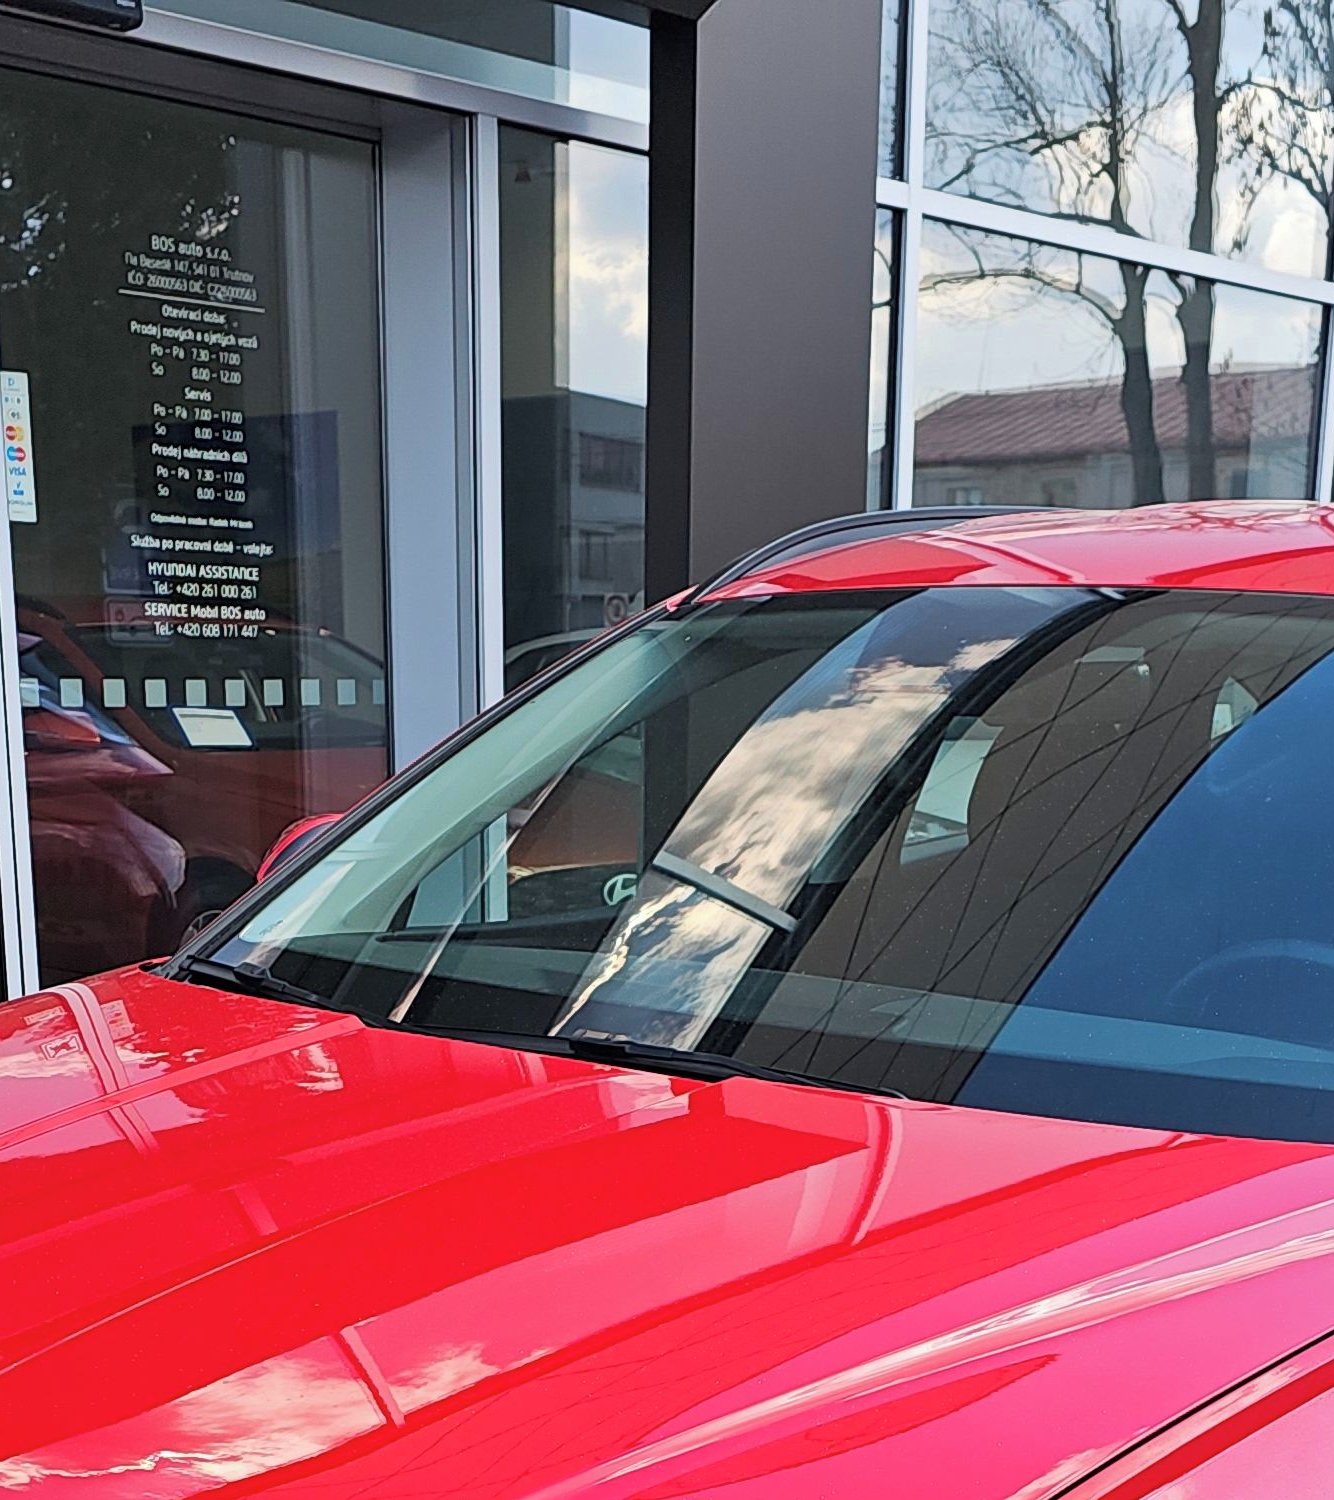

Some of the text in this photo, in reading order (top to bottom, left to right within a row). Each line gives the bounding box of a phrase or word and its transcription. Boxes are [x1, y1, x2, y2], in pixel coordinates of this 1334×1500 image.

[151, 235, 231, 261] BOS auto s.r.o.
[193, 262, 207, 275] 541
[223, 267, 254, 283] Trutnov
[131, 321, 161, 339] Prodej
[163, 327, 194, 341] nových
[151, 343, 163, 356] Po
[152, 362, 164, 375] So
[192, 367, 210, 381] 8.00
[220, 371, 242, 384] 12.00
[184, 386, 211, 401] Servis
[153, 403, 165, 416] Po
[193, 407, 212, 421] 7.00
[221, 411, 243, 424] 17.00
[155, 423, 166, 435] So
[194, 427, 212, 439] 8.00
[222, 430, 243, 442] 12.00
[152, 443, 181, 460] Prodej
[9, 467, 27, 476] VISA
[157, 465, 168, 477] Po
[197, 469, 214, 482] 7.30
[224, 472, 245, 484] 17.00
[158, 484, 169, 497] So
[197, 487, 215, 499] 8.00
[224, 490, 246, 502] 12.00
[131, 534, 160, 549] Služba
[162, 540, 173, 550] po
[148, 562, 260, 581] HYUNDAI ASSISTANCE
[176, 583, 199, 597] +420
[202, 584, 217, 597] 261
[221, 585, 238, 598] 000
[241, 585, 256, 599] 261
[145, 603, 266, 620] SERVICE Mobil BOS auto
[177, 623, 200, 636] +420
[202, 623, 220, 637] 608
[223, 624, 238, 637] 171
[241, 624, 258, 637] 447
